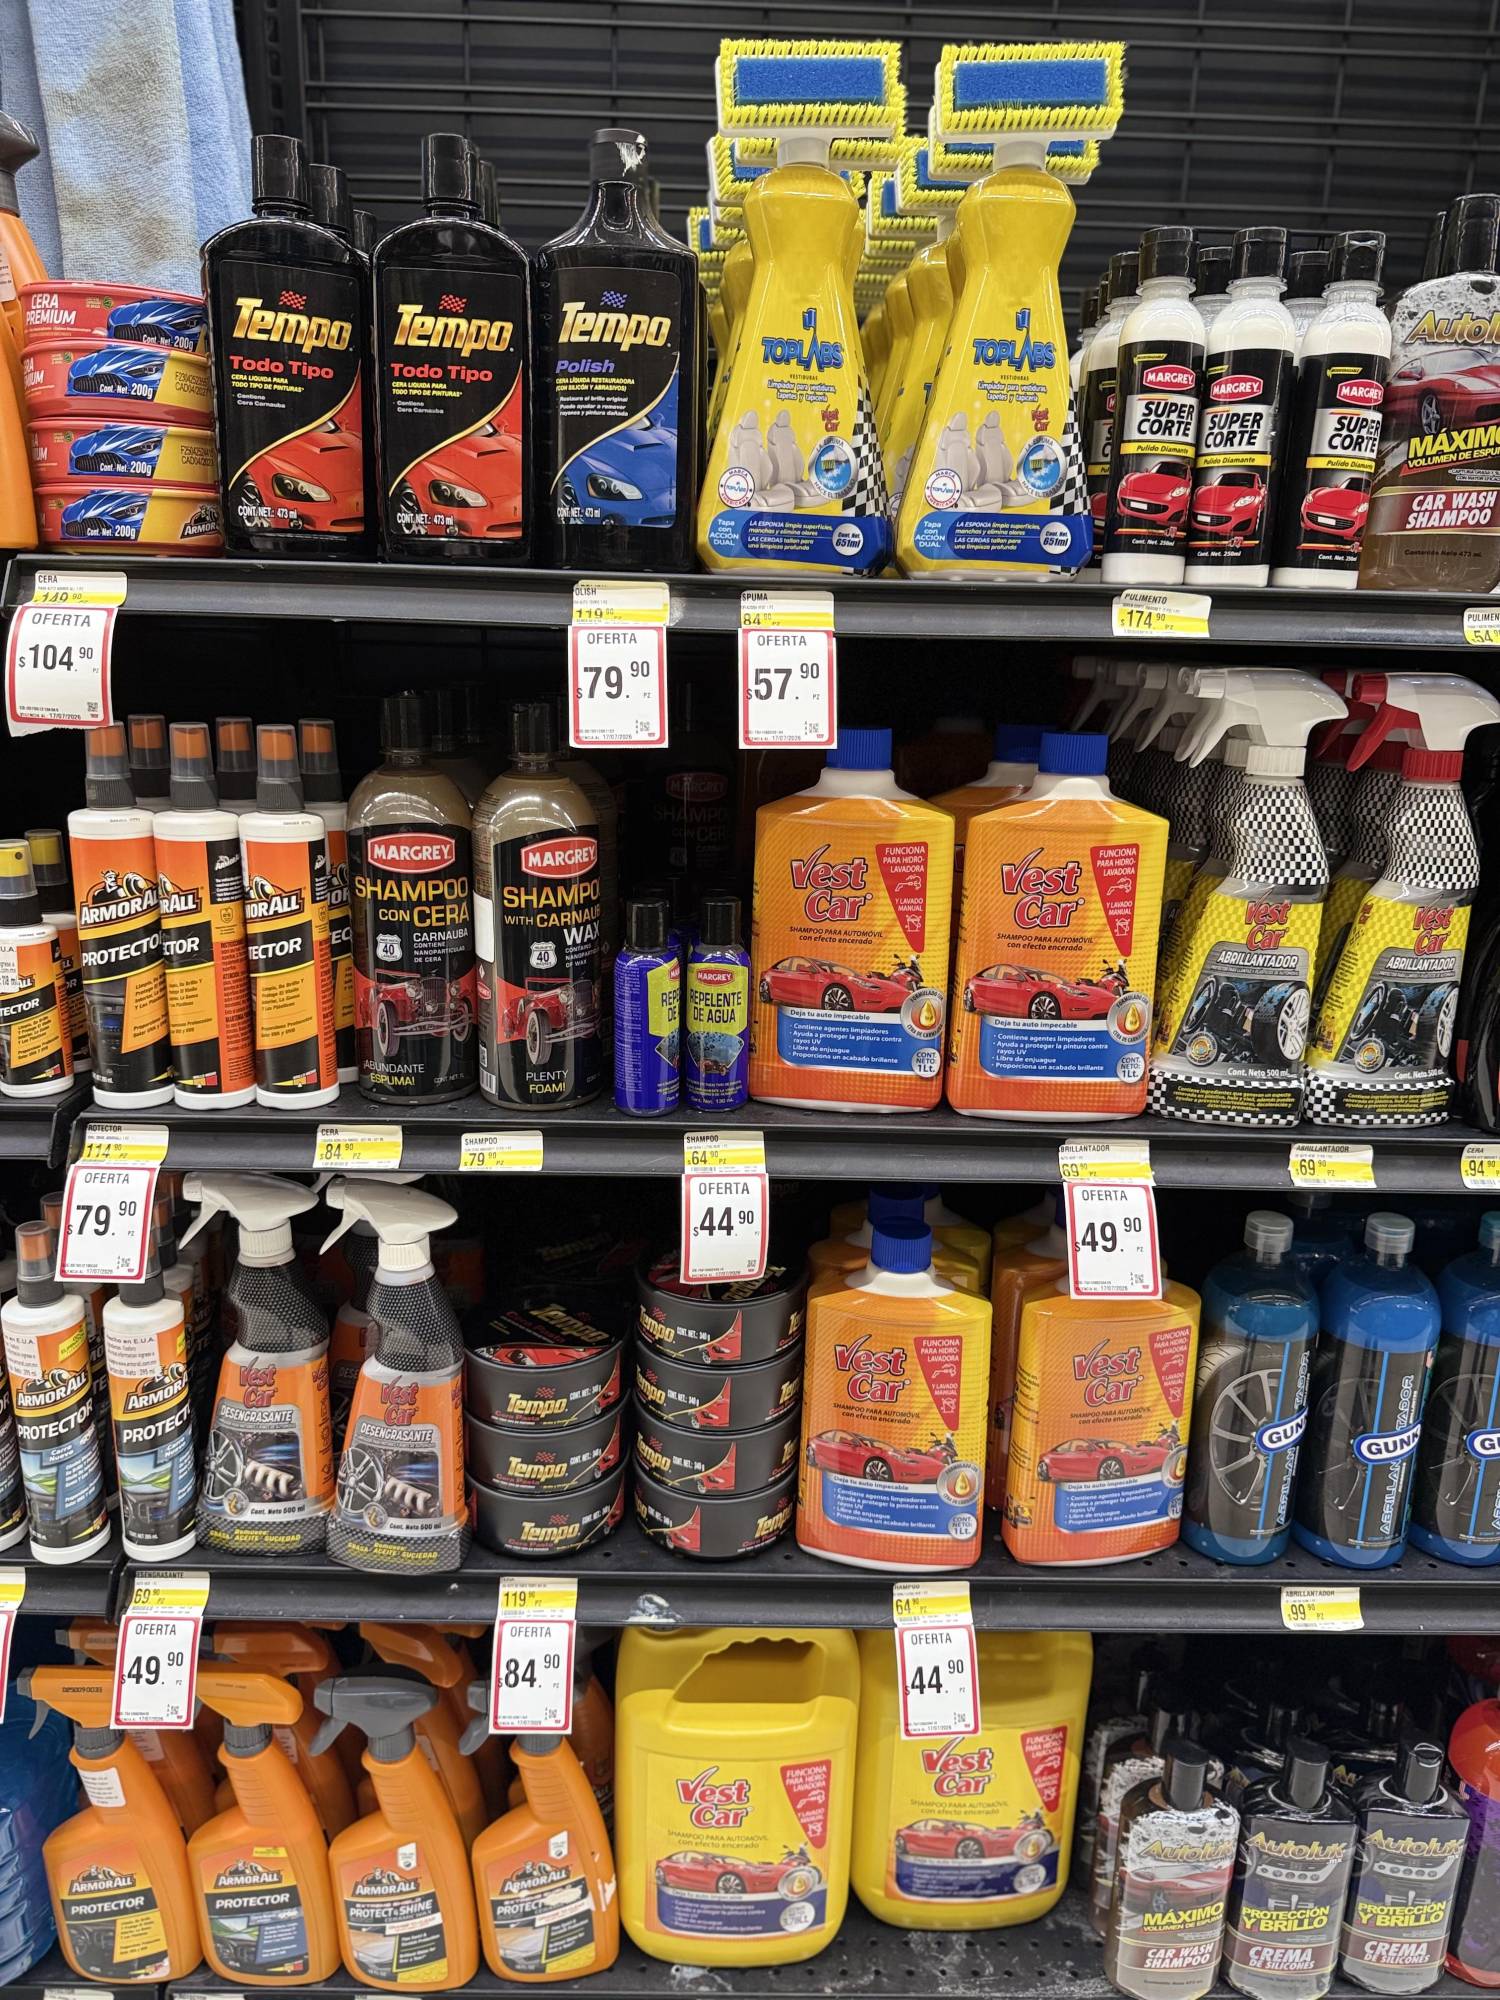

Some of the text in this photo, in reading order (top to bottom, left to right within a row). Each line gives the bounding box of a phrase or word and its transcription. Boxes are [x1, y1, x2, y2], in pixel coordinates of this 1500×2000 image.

[31, 294, 59, 309] CERA
[26, 309, 76, 325] PREMIUM
[231, 297, 352, 353] Tempo
[393, 302, 514, 357] Tempo
[558, 301, 671, 352] Tempo
[761, 332, 844, 371] TOPLABS
[973, 332, 1056, 371] TOPLABS
[229, 355, 334, 379] Todo Tipo
[391, 363, 493, 384] Todo Tipo
[555, 359, 615, 374] Polish
[231, 374, 251, 382] CERA
[231, 381, 248, 389] TODO
[250, 382, 262, 390] TIPO
[264, 383, 272, 391] DE
[1147, 370, 1194, 390] MARGREY
[99, 384, 153, 401] Cont. Net. 200g
[1212, 380, 1259, 395] MARGREY
[1142, 400, 1195, 421] SUPER
[1137, 418, 1192, 437] CORTE
[1208, 413, 1263, 431] SUPER
[1204, 429, 1259, 448] CORTE
[1136, 443, 1189, 454] Pulido Diamante
[1412, 490, 1498, 512] CAR WASH
[717, 518, 735, 528] Tapa
[1405, 507, 1492, 529] SHAMPOO
[713, 538, 735, 546] DUAL
[835, 538, 861, 547] 651ml
[38, 575, 58, 583] CERA
[1124, 592, 1168, 605] PULIMENTO
[32, 613, 91, 627] OFERTA
[587, 633, 637, 645] OFERTA
[757, 635, 807, 646] OFERTA
[373, 844, 450, 861] MARGREY
[528, 846, 596, 867] MARGREY
[885, 846, 925, 855] FUNCIONA
[790, 843, 867, 890] Vest
[890, 865, 924, 873] LAVADORA
[1002, 847, 1082, 895] Vest
[354, 876, 468, 901] SHAMPOO
[804, 889, 868, 923] Car
[1014, 895, 1078, 929] Car
[1245, 885, 1292, 925] Vest
[378, 903, 469, 928] CON CERA
[504, 914, 534, 927] WITH
[413, 928, 468, 942] CARNAUBA
[790, 926, 883, 938] SHAMPOO PARA AUTOMÓVIL
[814, 935, 836, 943] efecto
[837, 936, 873, 945] encerado
[1246, 925, 1286, 951] Car
[1216, 951, 1298, 969] ABRILLANTADOR
[1385, 956, 1455, 971] ABRILLANTADOR
[697, 971, 732, 982] MARGREY
[689, 991, 742, 1007] REPELENTE
[693, 1007, 736, 1023] DE AGUA
[790, 1010, 806, 1018] Deja
[833, 1013, 870, 1021] impecable
[370, 1073, 416, 1086] ESPUMA!
[526, 1069, 568, 1082] PLENTY
[1227, 1067, 1280, 1077] Cont. Neto 500
[529, 1082, 566, 1094] FOAM!
[321, 1128, 339, 1136] CERA
[686, 1135, 719, 1143] SHAMPOO
[464, 1137, 497, 1145] SHAMPOO
[84, 1173, 130, 1185] OFERTA
[699, 1182, 750, 1195] OFERTA
[1082, 1190, 1128, 1201] OFERTA
[834, 1334, 907, 1376] Vest
[239, 1356, 277, 1387] Vest
[848, 1373, 906, 1403] Car
[243, 1387, 275, 1408] Car
[507, 1392, 568, 1415] Tempo
[18, 1398, 93, 1440] PROTECTOR
[220, 1406, 294, 1423] DESENGRASANTE
[360, 1422, 434, 1442] DESENGRASANTE
[1366, 1424, 1421, 1456] GUNK
[49, 1450, 73, 1461] Nuevo
[51, 1445, 73, 1456] Carro
[508, 1456, 568, 1479] Tempo
[521, 1521, 580, 1544] Tempo
[1285, 1590, 1335, 1598] ABRILLANTADOR
[135, 1623, 177, 1636] OFERTA
[510, 1626, 552, 1638] OFERTA
[911, 1633, 952, 1645] OFERTA
[922, 1736, 994, 1774] Vest
[676, 1766, 750, 1804] Vest
[934, 1773, 991, 1797] Car
[690, 1804, 749, 1828] Car
[71, 1896, 145, 1915] PROTECTOR
[215, 1893, 290, 1910] PROTECTOR
[1358, 1901, 1446, 1916] PROTECCIÓN
[1143, 1902, 1224, 1926] MÁXIMO
[1242, 1905, 1330, 1919] PROTECCIÓN
[1358, 1910, 1445, 1928] Y BRILLO
[1243, 1915, 1329, 1933] Y BRILLO
[1147, 1942, 1214, 1960] CAR WASH
[1249, 1947, 1313, 1963] CREMA
[1364, 1941, 1429, 1957] CREMA
[1143, 1953, 1211, 1970] SHAMPOO
[1249, 1958, 1315, 1971] DE SILICONES
[1364, 1954, 1431, 1965] DE SILICONES
